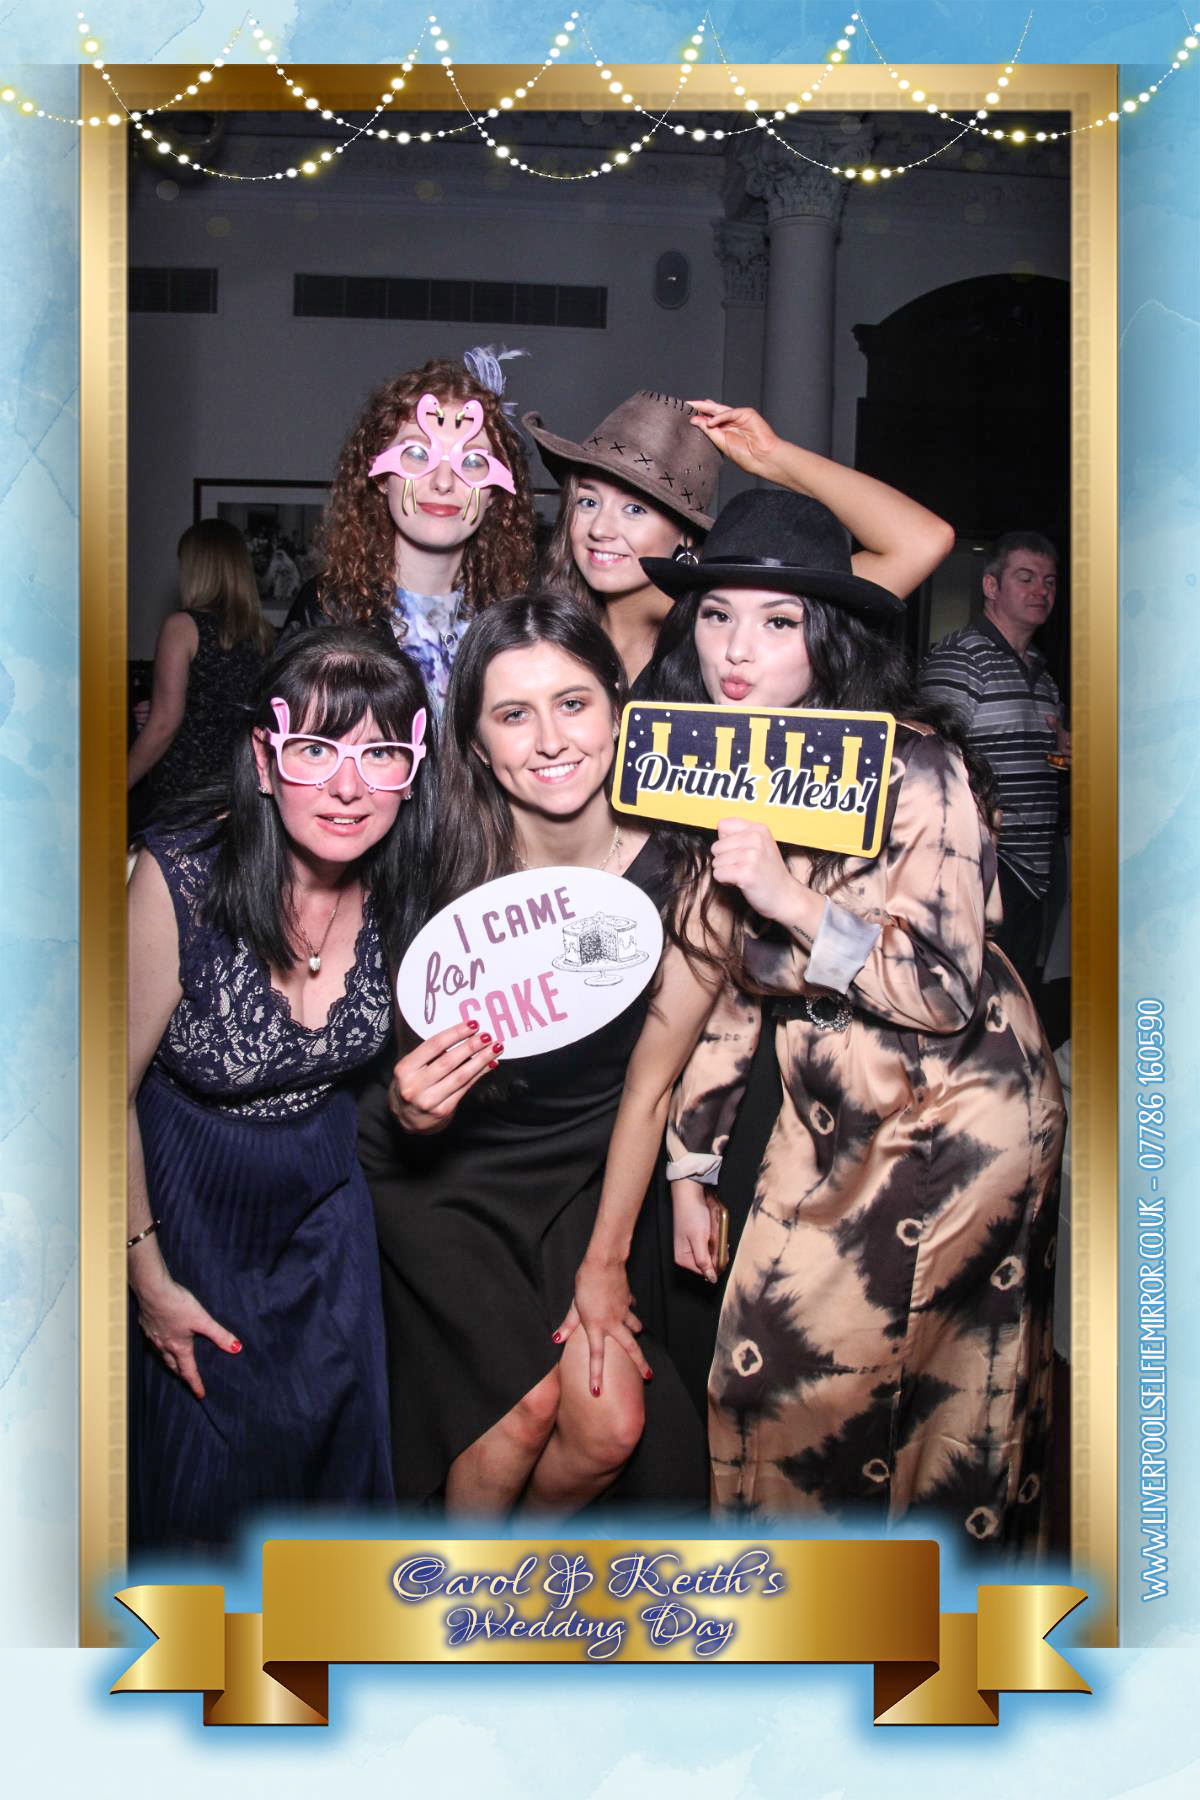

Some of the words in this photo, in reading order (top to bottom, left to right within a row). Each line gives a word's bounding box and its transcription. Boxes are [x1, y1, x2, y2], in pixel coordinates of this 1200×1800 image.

[635, 753, 756, 801] Drunk
[767, 768, 877, 814] Mess!
[453, 913, 471, 954] I
[482, 886, 576, 944] CAME
[424, 951, 485, 1024] for
